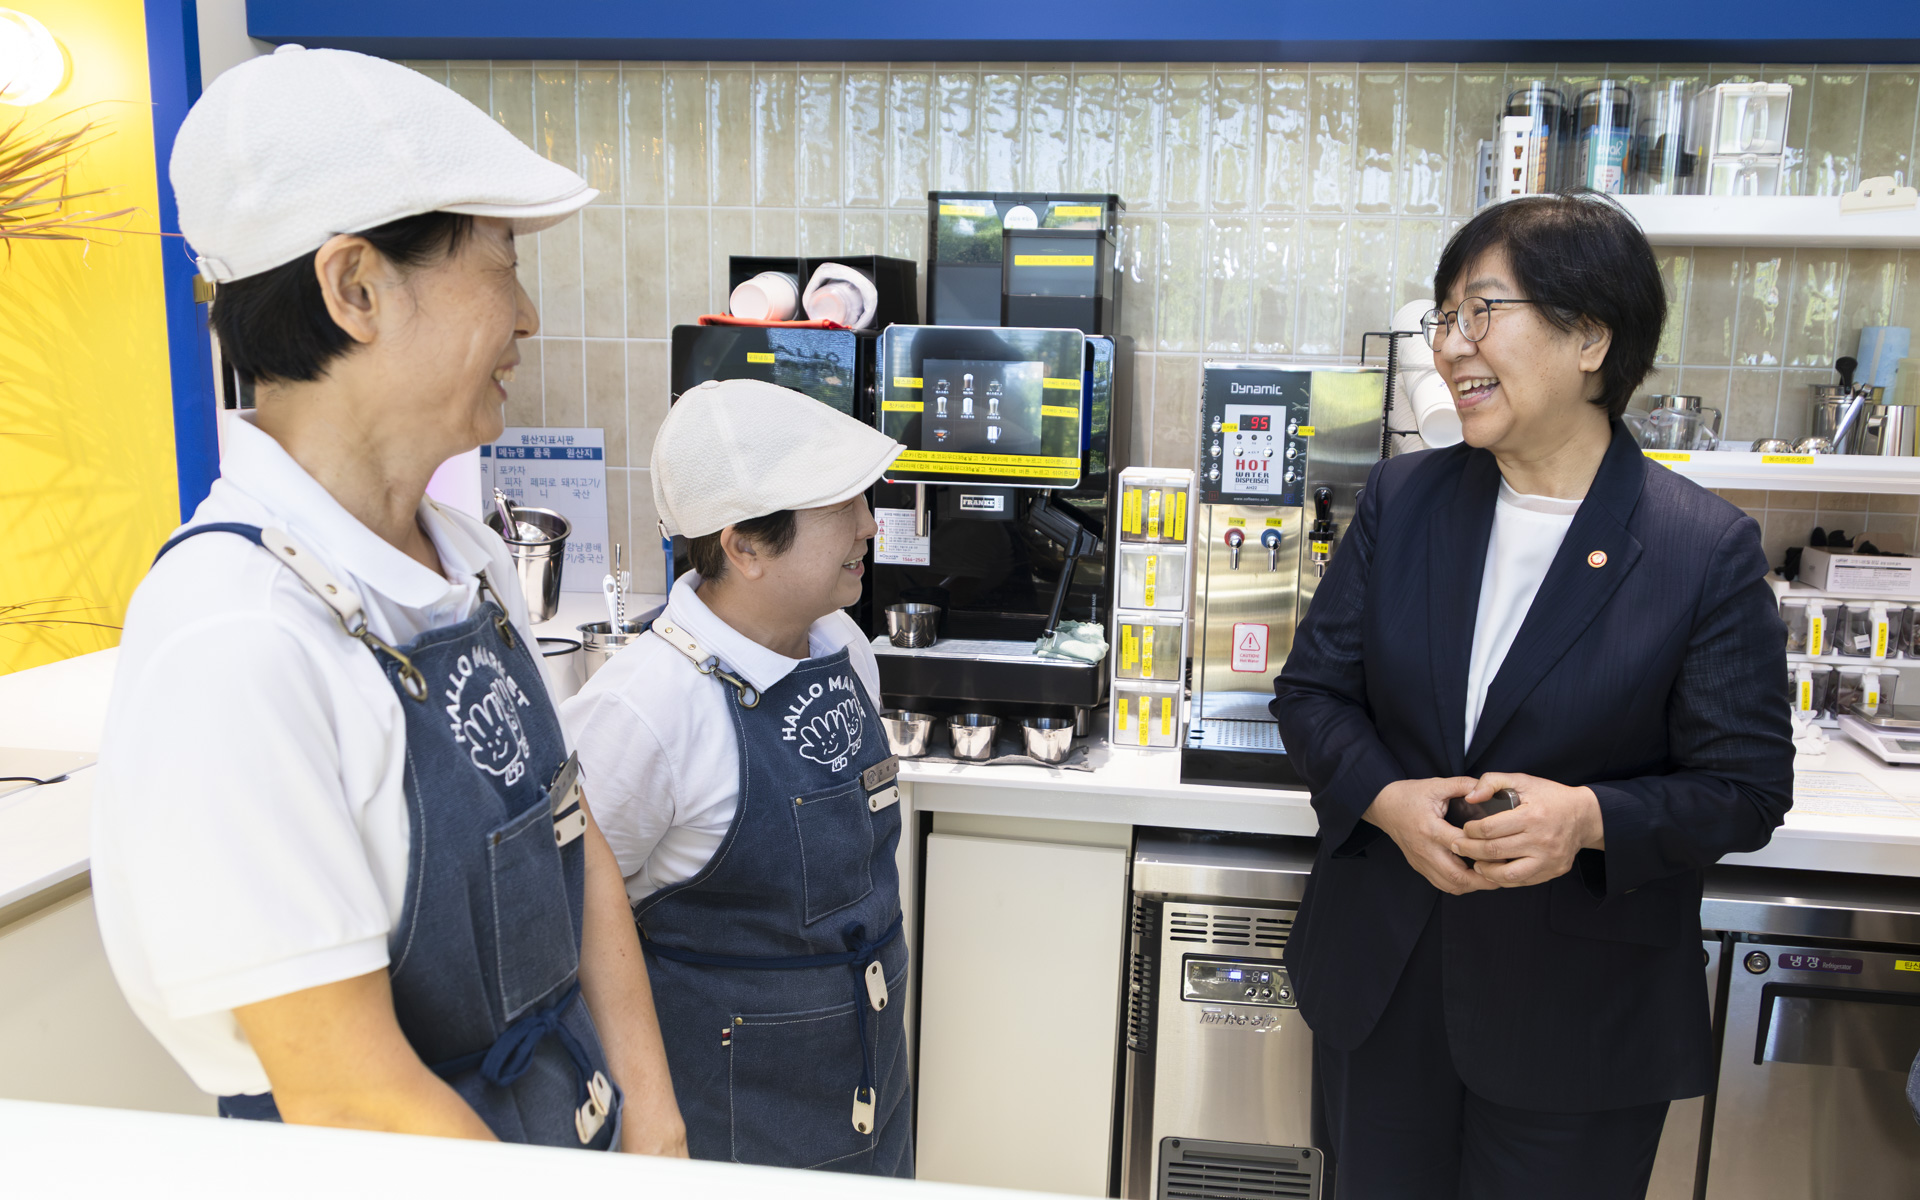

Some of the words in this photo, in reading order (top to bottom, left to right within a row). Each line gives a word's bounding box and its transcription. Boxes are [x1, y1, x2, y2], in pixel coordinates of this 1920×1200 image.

[1230, 382, 1283, 395] Dynamic
[1250, 416, 1269, 430] 95
[521, 434, 575, 446] 원산지표시판
[498, 447, 525, 457] 메뉴명
[533, 447, 551, 458] 품목
[566, 448, 593, 459] 원산지
[500, 465, 526, 476] 포카차
[1235, 459, 1270, 471] HOT
[504, 477, 522, 487] 피자
[530, 477, 557, 487] 페퍼로
[561, 478, 601, 489] 돼지고기/
[540, 489, 548, 499] 니
[572, 489, 590, 500] 국산
[962, 498, 995, 508] FRANKE
[565, 553, 604, 564] 기/중국산
[446, 655, 473, 743] HALLO
[782, 683, 823, 741] HALLO
[1822, 961, 1852, 971] Refrigerator
